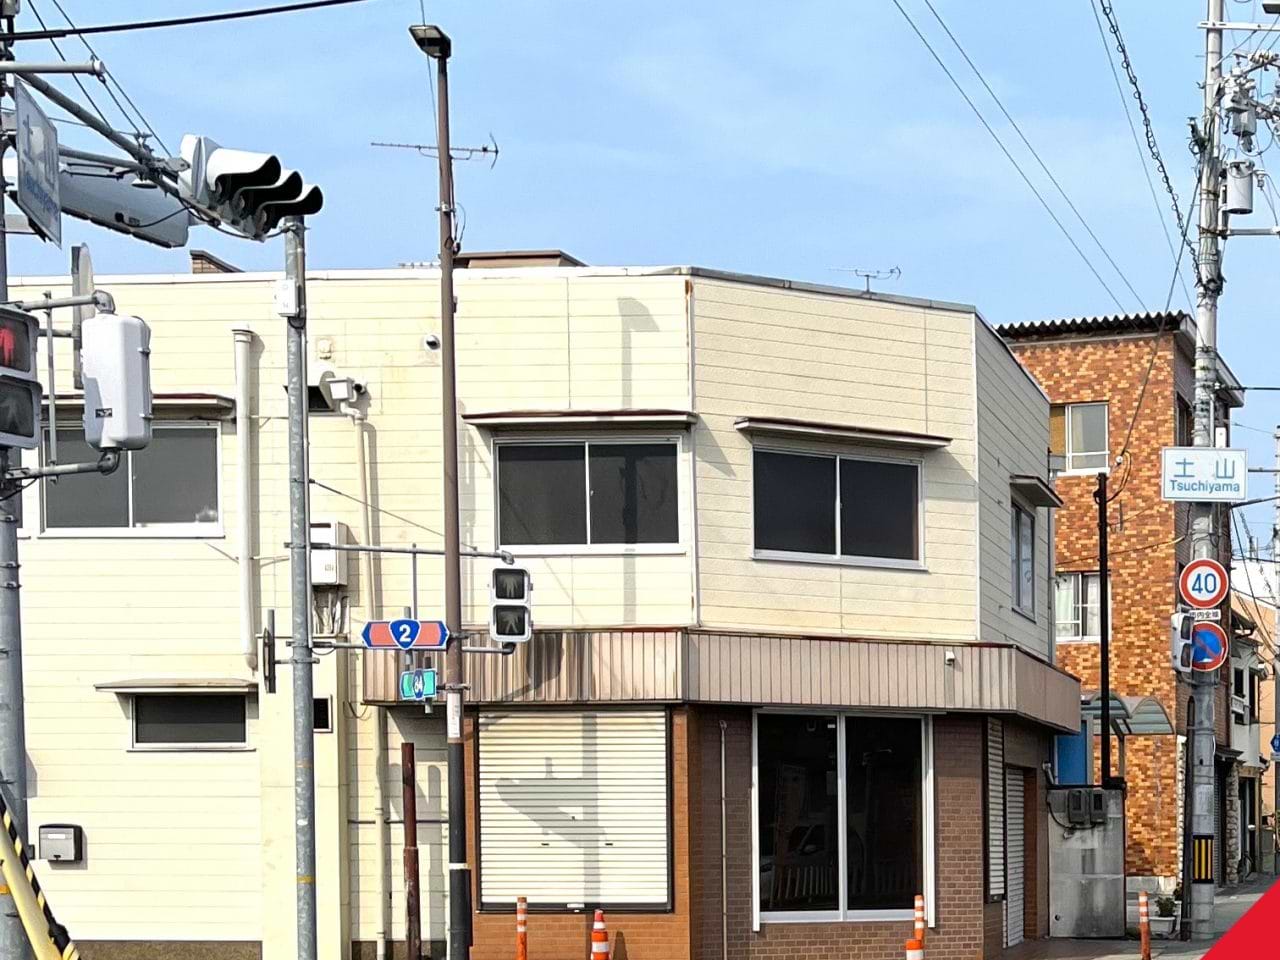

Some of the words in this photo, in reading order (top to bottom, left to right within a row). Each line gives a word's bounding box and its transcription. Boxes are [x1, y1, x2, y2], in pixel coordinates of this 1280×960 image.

[1173, 457, 1235, 479] 土山
[1169, 479, 1240, 494] Tsuchiyama
[1191, 573, 1217, 593] 40
[399, 624, 412, 642] 2
